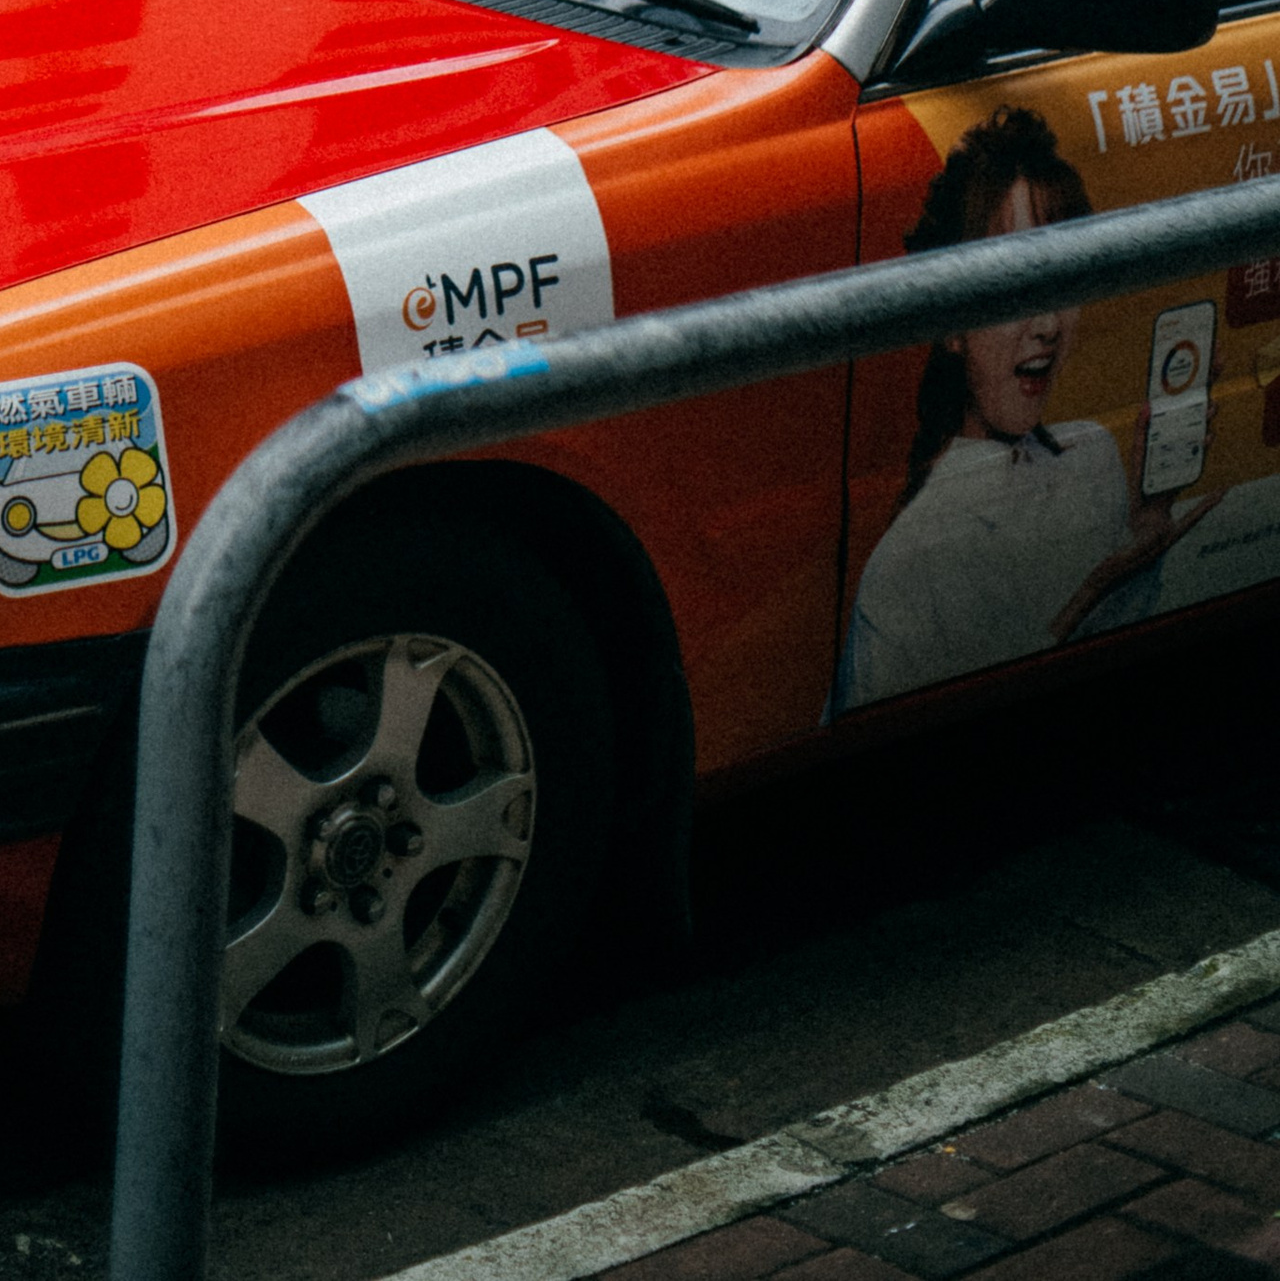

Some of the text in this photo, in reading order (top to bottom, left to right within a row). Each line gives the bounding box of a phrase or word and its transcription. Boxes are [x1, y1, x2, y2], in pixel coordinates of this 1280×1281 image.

[1088, 60, 1280, 153] 「積金易」
[60, 545, 102, 567] LPG
